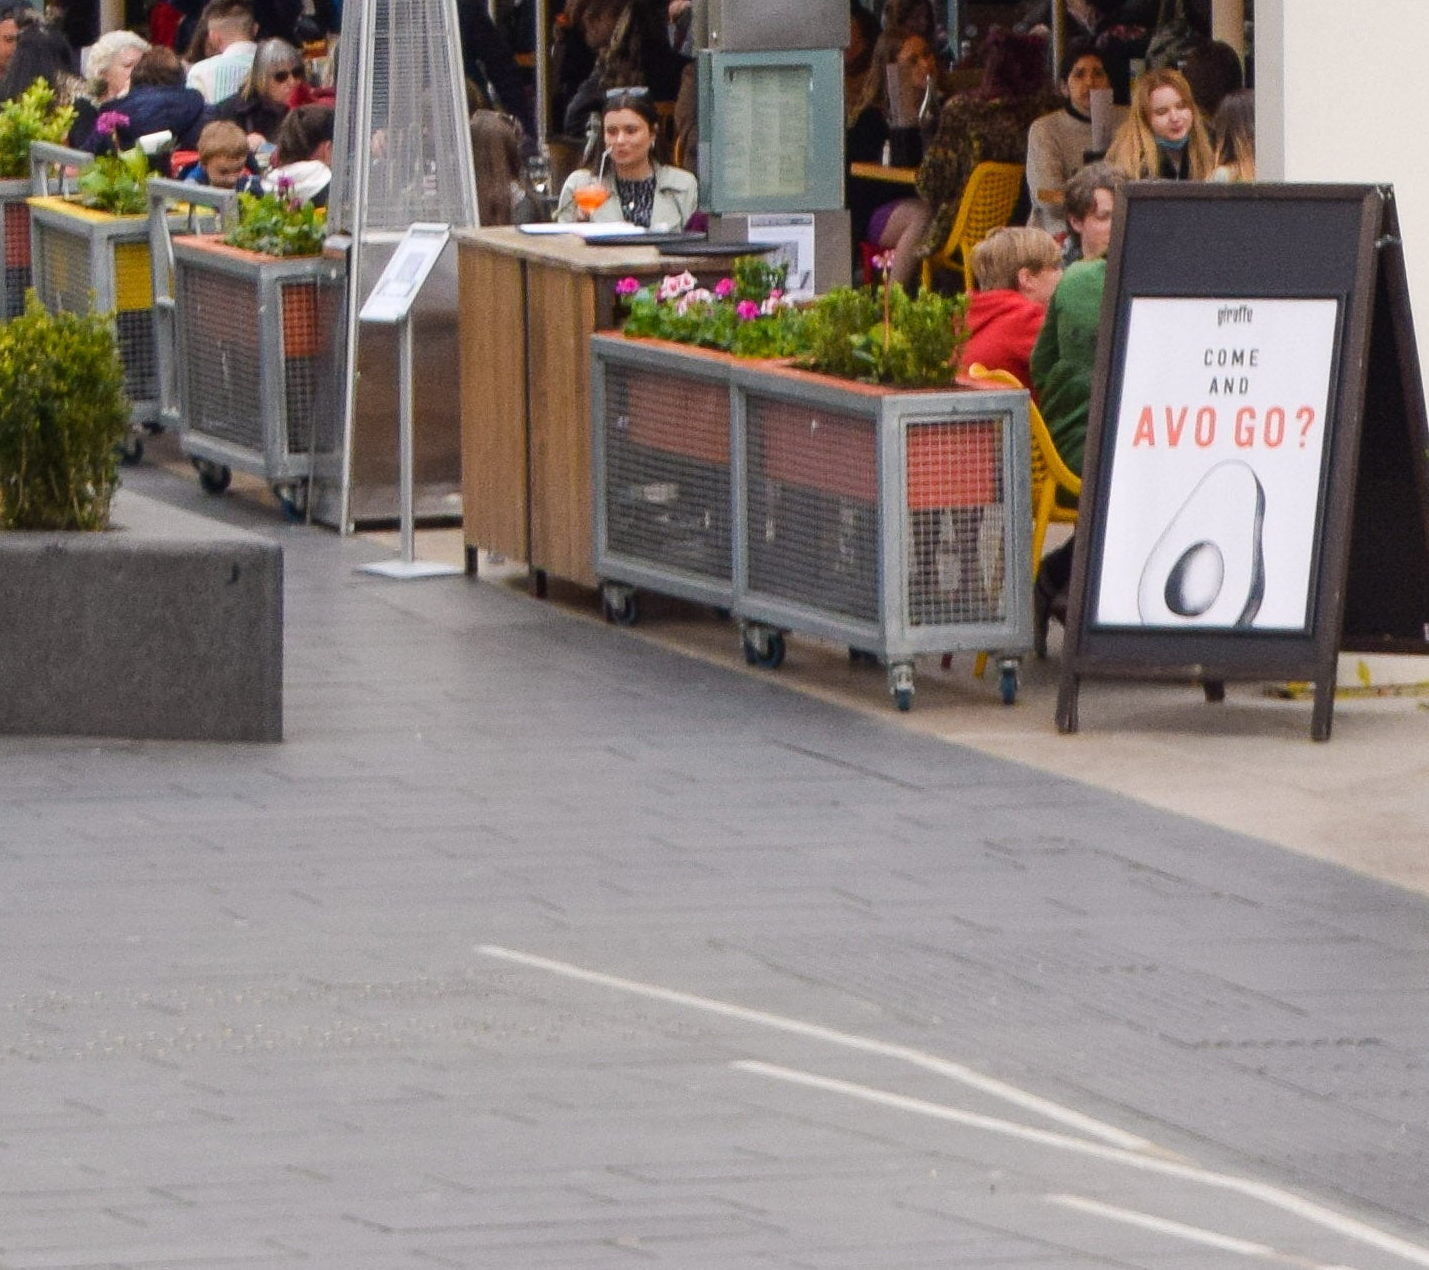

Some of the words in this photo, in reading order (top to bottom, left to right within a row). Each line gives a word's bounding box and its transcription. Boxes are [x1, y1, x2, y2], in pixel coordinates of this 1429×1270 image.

[1217, 304, 1254, 327] giraffe
[1204, 348, 1260, 367] COME
[1209, 377, 1249, 395] AND
[1132, 404, 1218, 448] AVO
[1233, 404, 1316, 448] GO?
